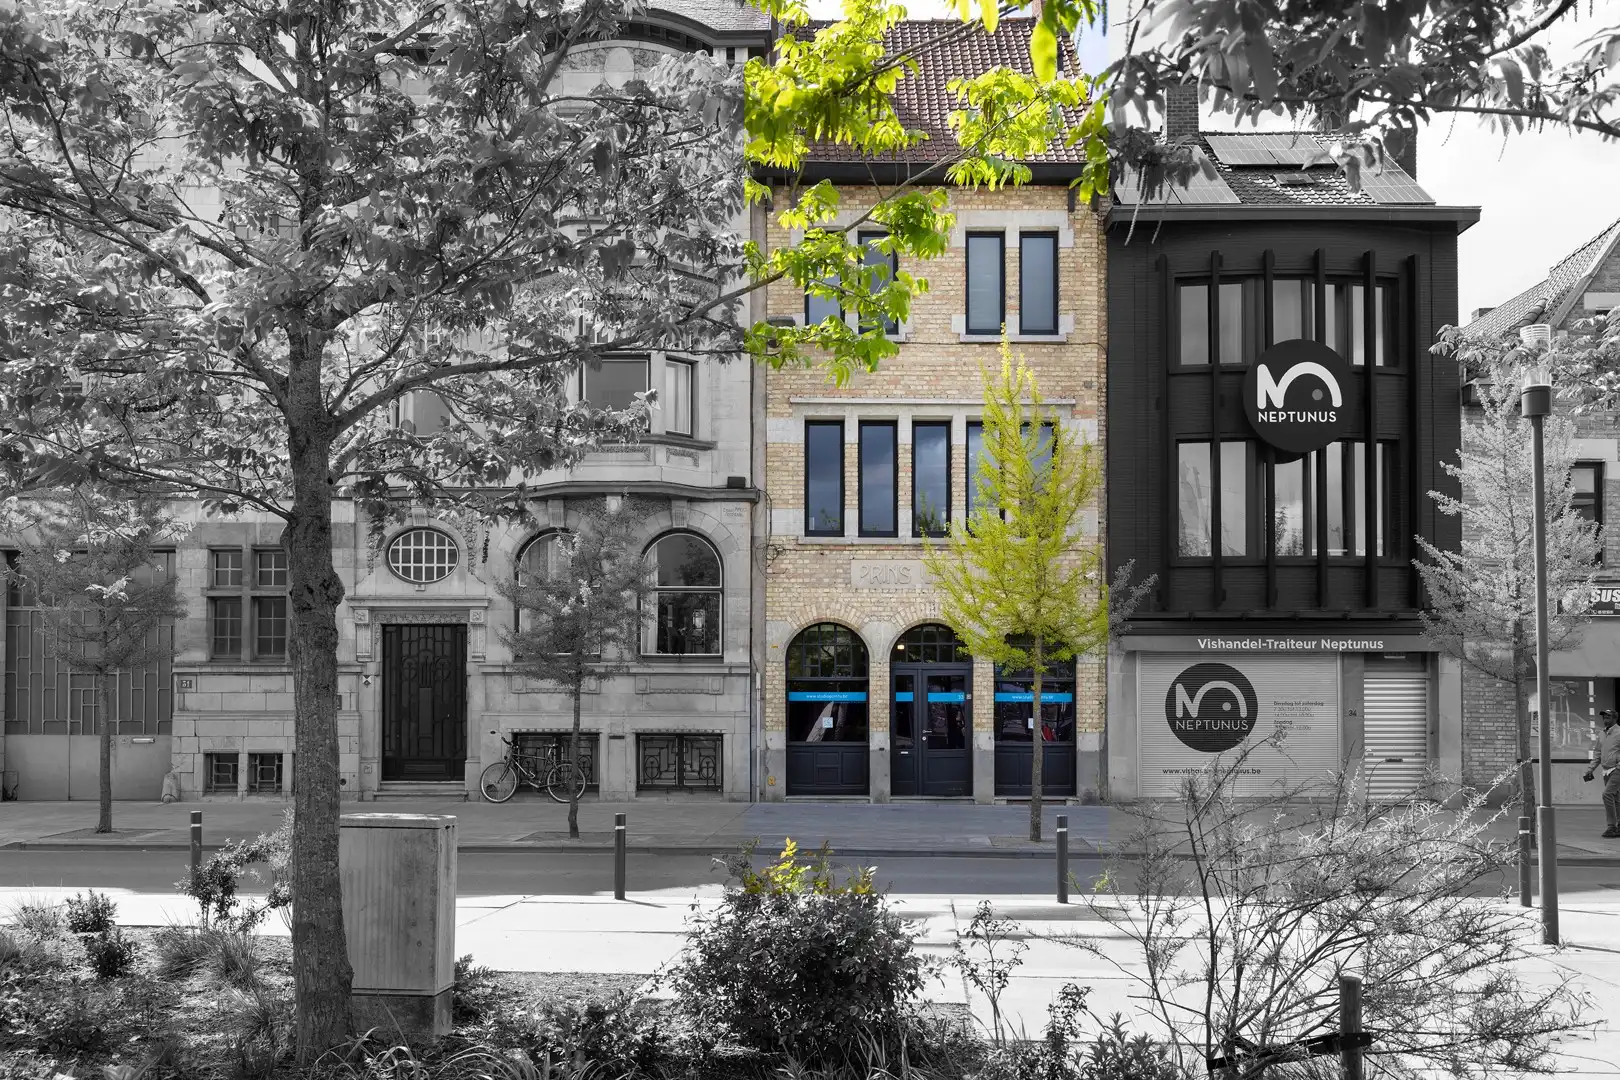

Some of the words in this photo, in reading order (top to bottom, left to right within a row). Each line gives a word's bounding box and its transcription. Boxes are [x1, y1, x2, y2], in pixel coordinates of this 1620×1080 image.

[1258, 411, 1337, 423] NEPTUNUS
[859, 564, 912, 585] PRINS
[1197, 638, 1317, 650] Vishandel-Traiteur
[1320, 638, 1384, 652] Neptunus
[1175, 719, 1249, 731] NEPTUNUS
